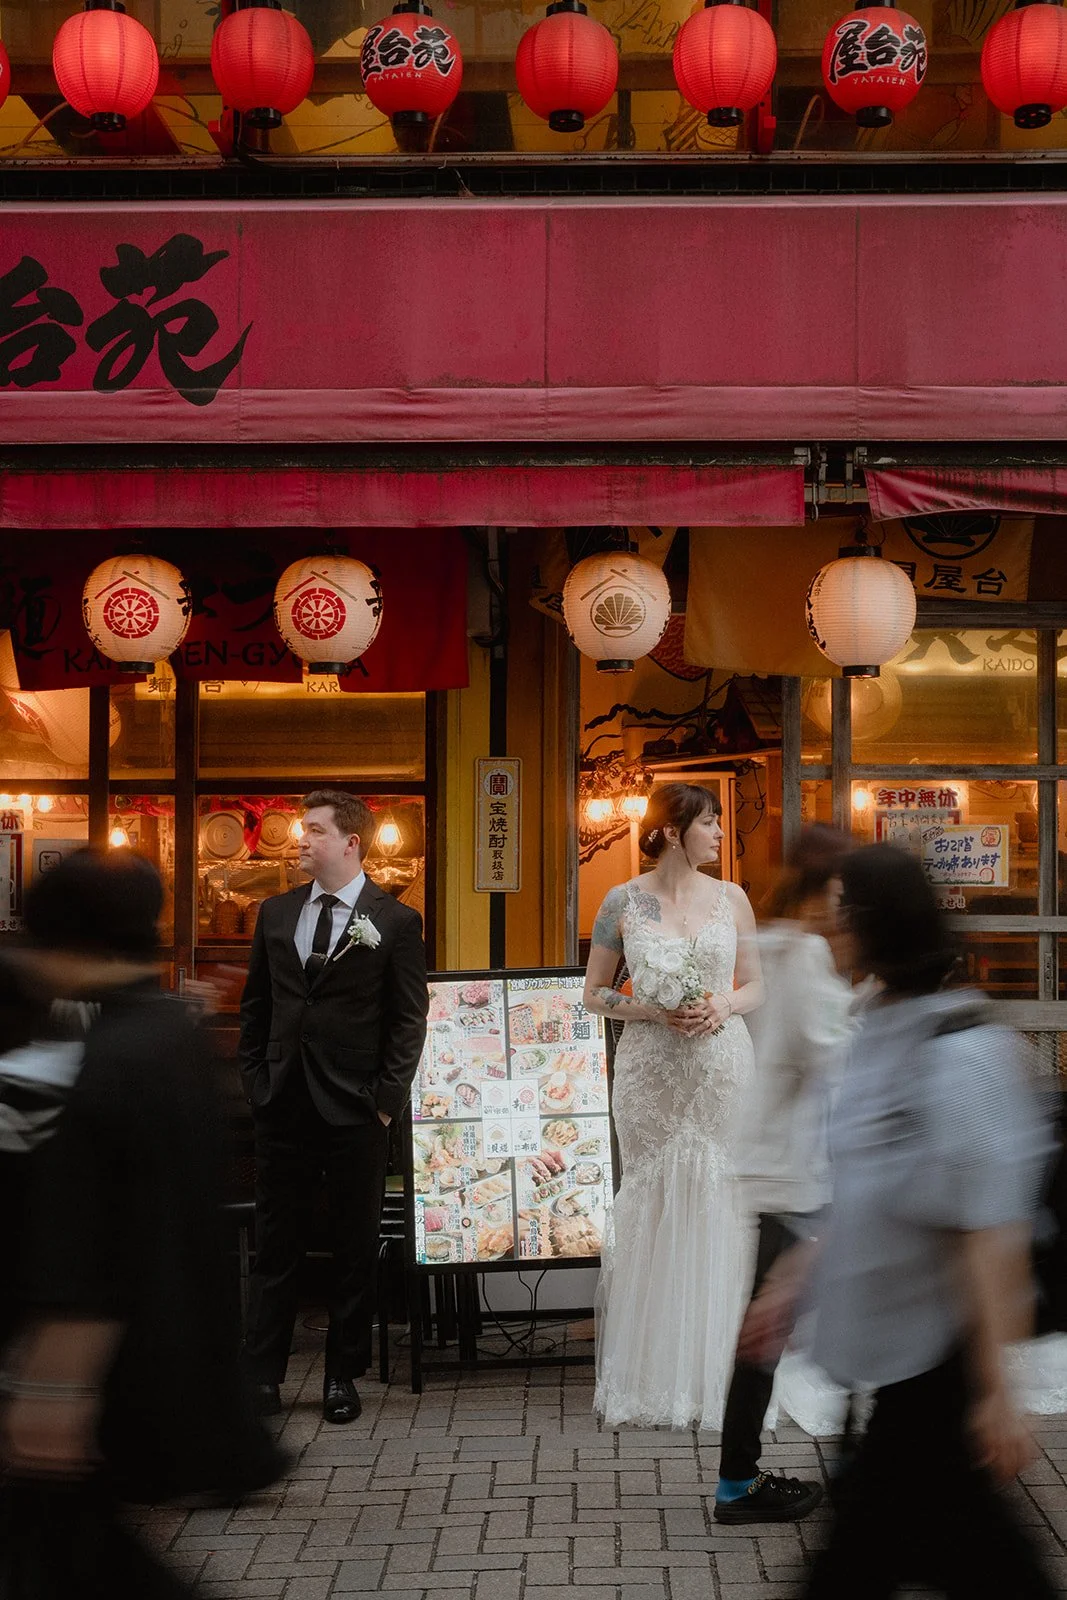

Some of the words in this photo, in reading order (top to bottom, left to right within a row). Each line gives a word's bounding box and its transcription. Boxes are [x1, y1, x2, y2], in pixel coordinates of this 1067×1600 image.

[828, 19, 927, 85] 屋台苑
[853, 75, 906, 85] YATAIEN
[982, 657, 1035, 671] KAIDO
[878, 788, 959, 808] 年中無休
